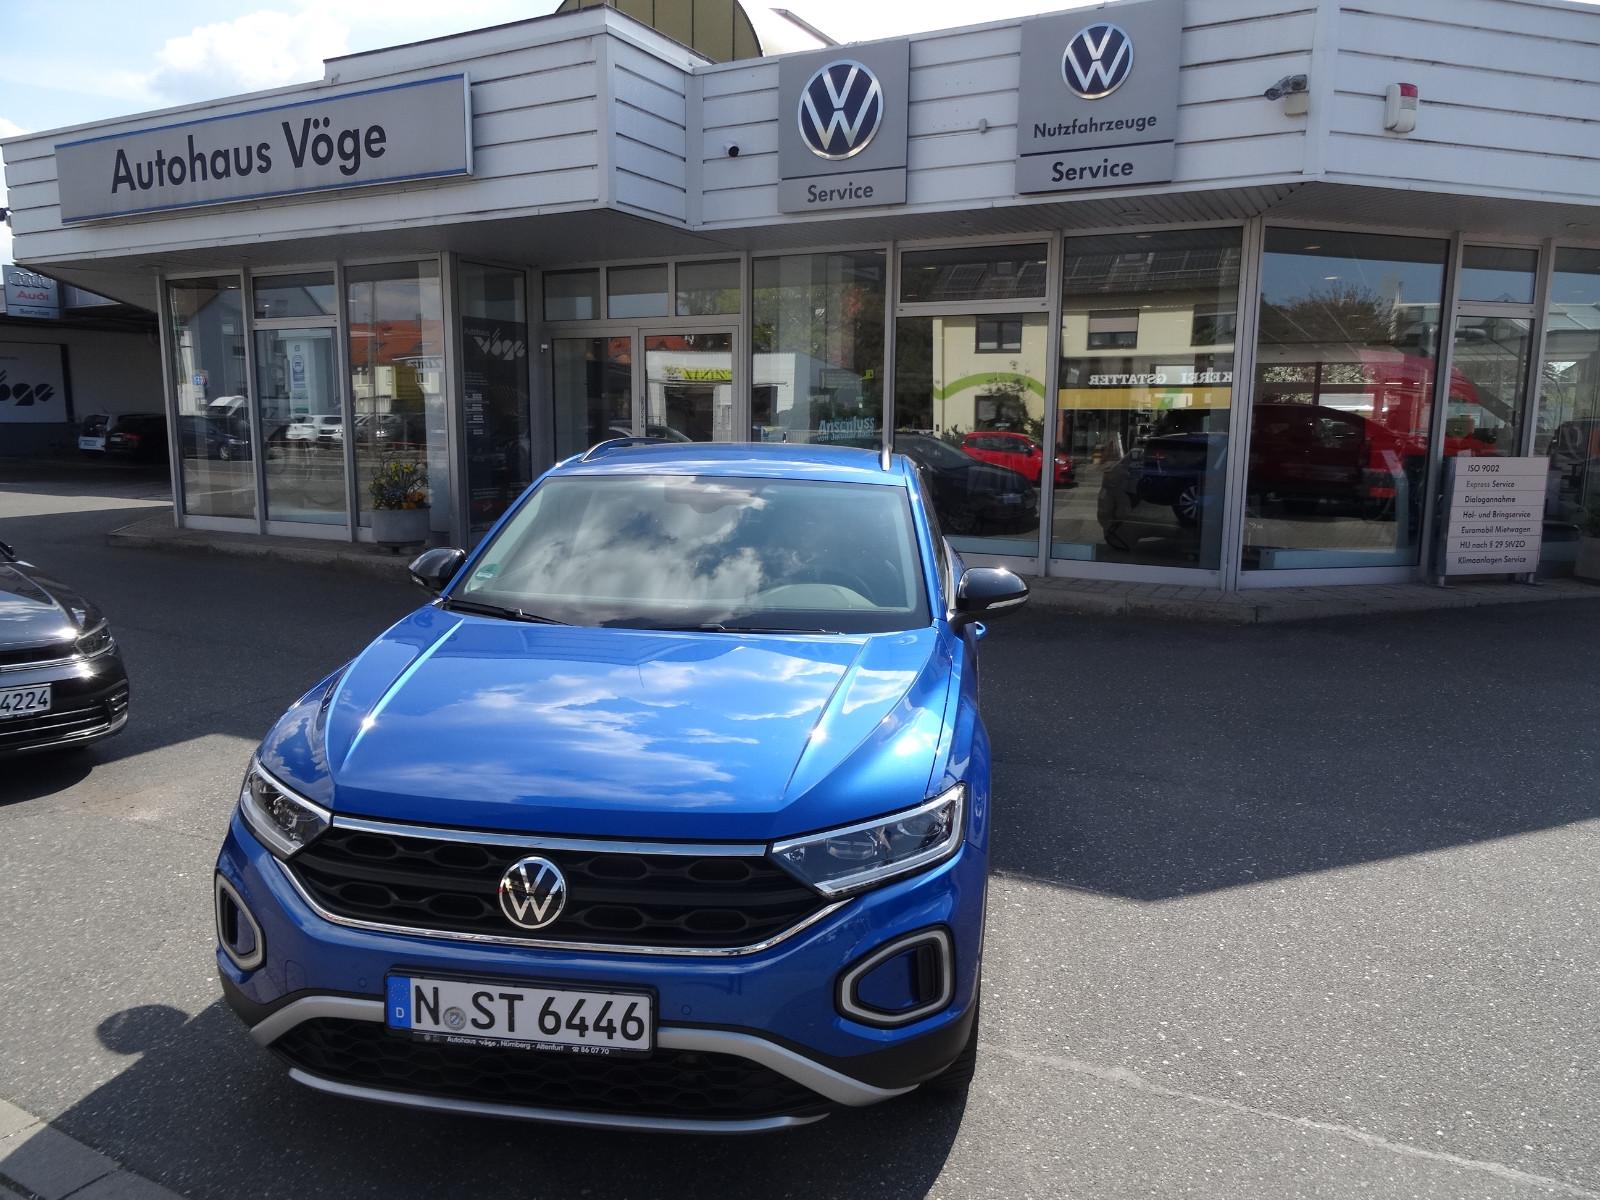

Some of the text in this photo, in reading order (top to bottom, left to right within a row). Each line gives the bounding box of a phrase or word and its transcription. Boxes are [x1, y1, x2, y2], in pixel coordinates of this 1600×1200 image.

[1033, 114, 1157, 139] Nutzfahrzeuge
[111, 117, 387, 194] Autohaus Vöge
[1051, 158, 1134, 183] Service
[807, 182, 874, 203] Service
[16, 290, 49, 300] Audi
[1482, 464, 1500, 472] 9002
[1466, 480, 1515, 489] Express Service
[1464, 495, 1516, 504] Dialogannahme
[1478, 510, 1491, 518] und
[1492, 510, 1531, 520] Bringservice
[1461, 526, 1531, 535] Euromobil Mietwagen
[1459, 541, 1471, 549] HU
[1472, 541, 1488, 549] nach
[1495, 540, 1504, 548] 29
[1504, 540, 1526, 548] StVZO
[1457, 556, 1502, 566] Klimaanlagen
[0, 690, 48, 712] 4224
[396, 1007, 405, 1018] D
[414, 985, 645, 1042] N ST 6446
[446, 1036, 476, 1045] Autohaus
[500, 1040, 531, 1049] Nürnberg
[536, 1042, 564, 1051] Altenfurt
